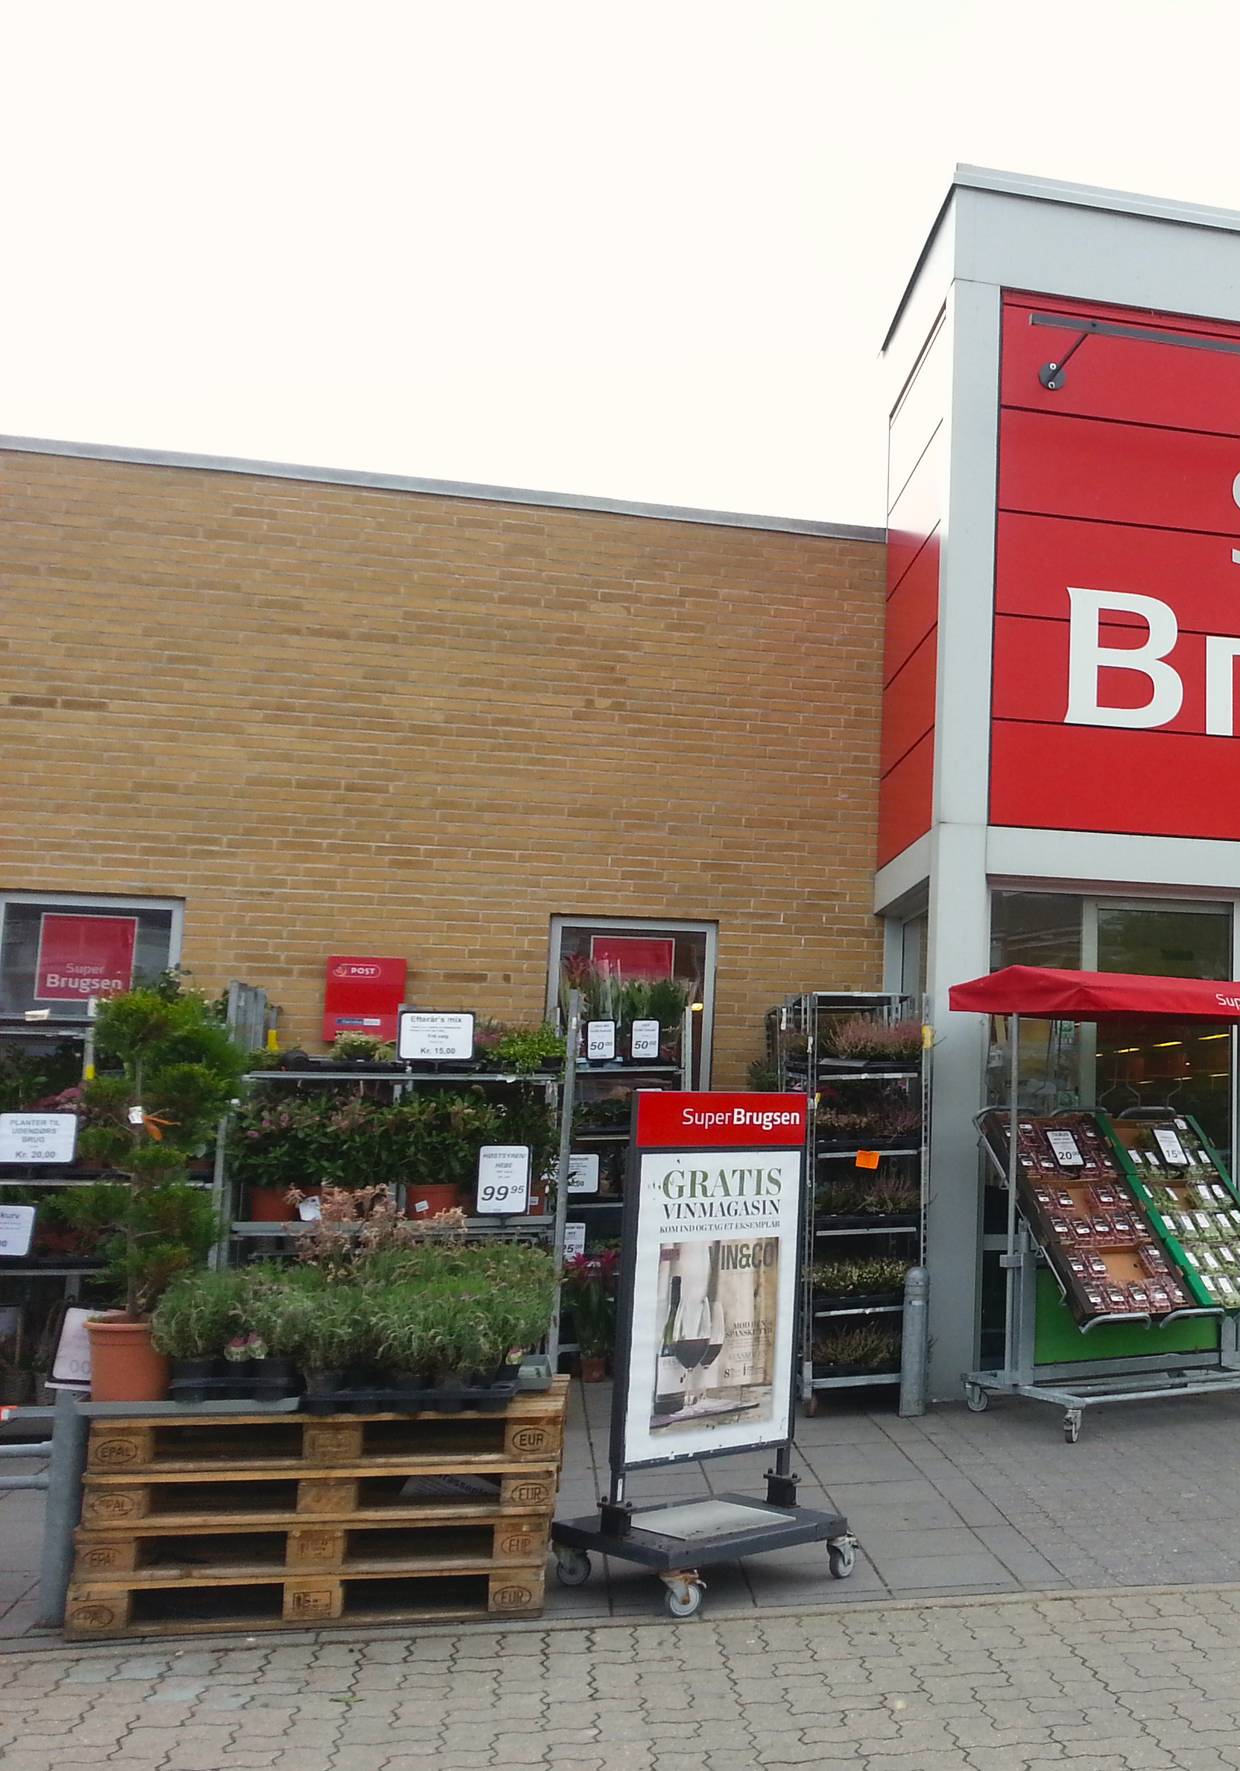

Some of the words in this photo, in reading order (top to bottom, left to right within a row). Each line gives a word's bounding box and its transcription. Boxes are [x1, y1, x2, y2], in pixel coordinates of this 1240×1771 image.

[65, 963, 104, 975] Super
[351, 967, 376, 975] POST
[46, 973, 122, 993] Brugsen
[420, 1047, 431, 1055] Kr.
[590, 1041, 604, 1050] 50
[634, 1041, 648, 1050] 50
[682, 1108, 800, 1131] SuperBrugsen
[1059, 1152, 1073, 1161] 20
[1166, 1151, 1178, 1159] 15
[662, 1168, 782, 1200] GRATIS
[481, 1186, 509, 1201] 99
[510, 1185, 525, 1194] 95
[663, 1200, 781, 1220] VINMAGASIN
[660, 1225, 678, 1233] KOM
[679, 1224, 695, 1232] IND
[696, 1223, 708, 1232] OG
[708, 1222, 723, 1231] TAG
[724, 1221, 734, 1230] ET
[735, 1220, 780, 1229] EKSEMPLAR
[709, 1241, 775, 1270] VIN&CO
[519, 1433, 544, 1446] EUR
[100, 1446, 132, 1459] EPAL
[518, 1488, 541, 1501] EUR
[501, 1591, 524, 1605] EUR
